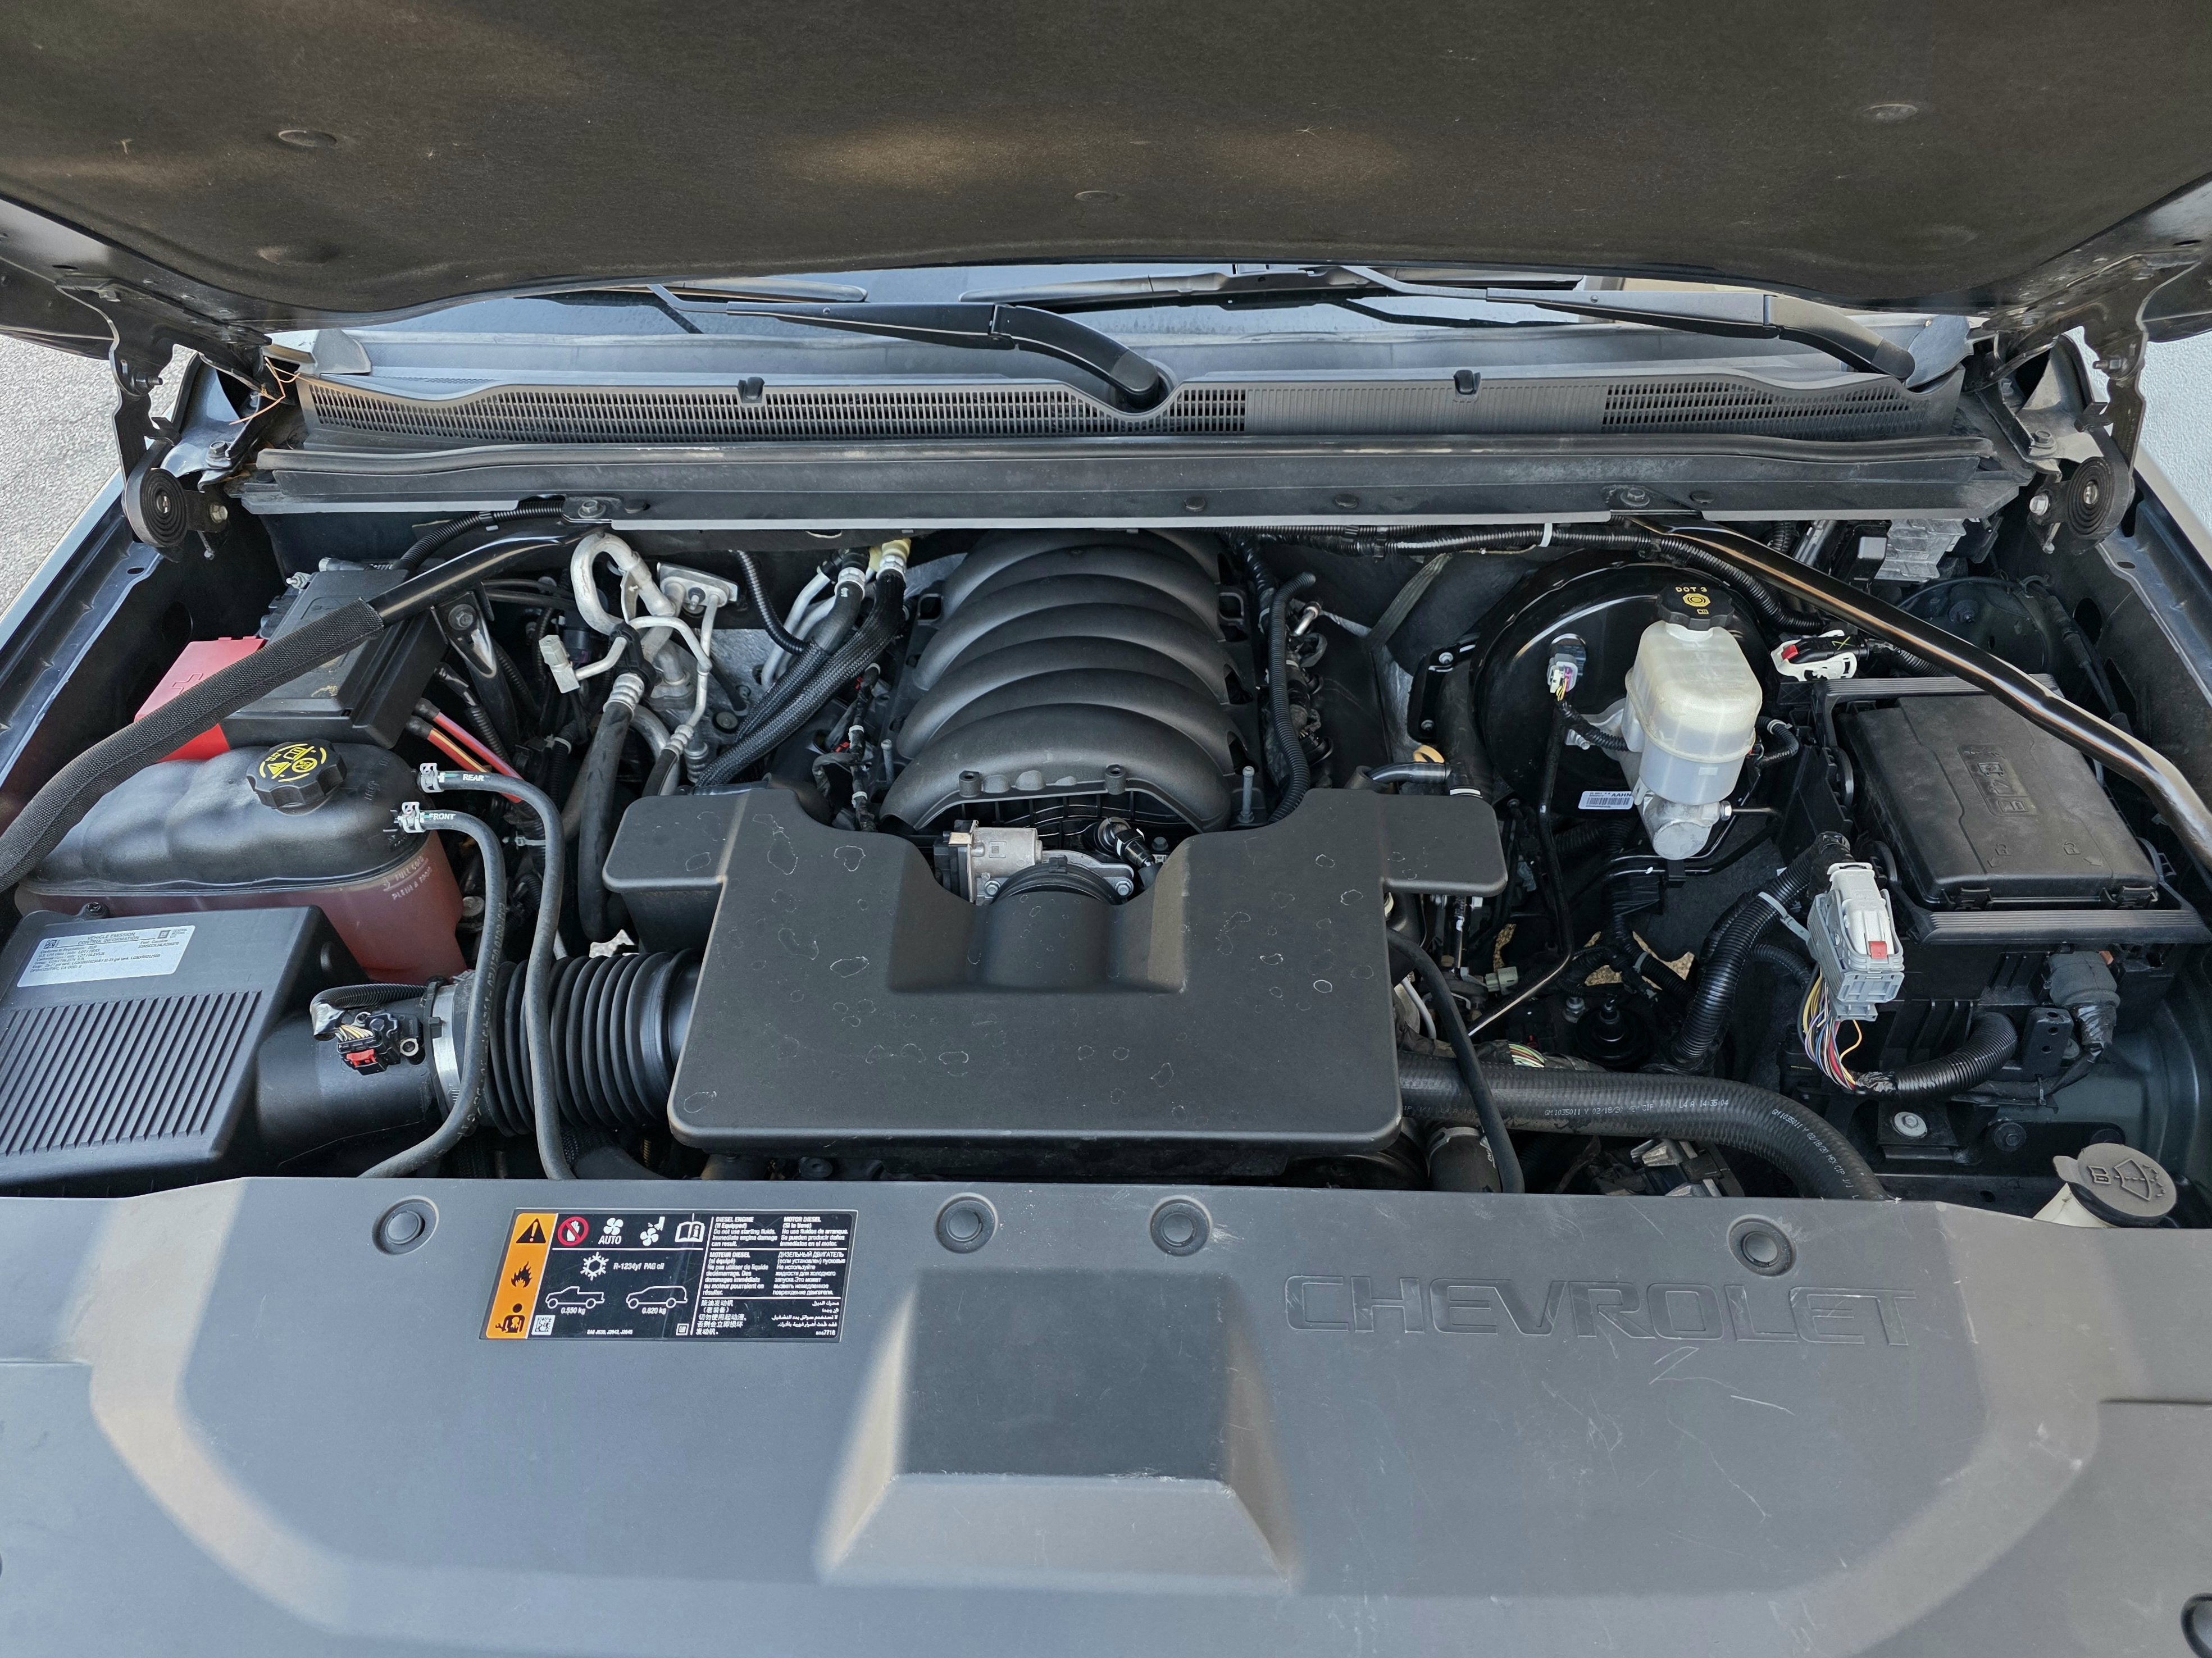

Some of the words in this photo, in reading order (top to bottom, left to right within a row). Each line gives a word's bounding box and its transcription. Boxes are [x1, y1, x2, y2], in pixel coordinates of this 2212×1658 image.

[1780, 1113, 1803, 1129] 1035011
[1806, 1133, 1829, 1154] 02/18/20
[1826, 1154, 1837, 1165] MEX
[1835, 1165, 1845, 1175] CIP
[598, 1236, 621, 1245] AUTO
[613, 1263, 641, 1271] R-1234yf
[1285, 1274, 1917, 1346] CHEVROLET
